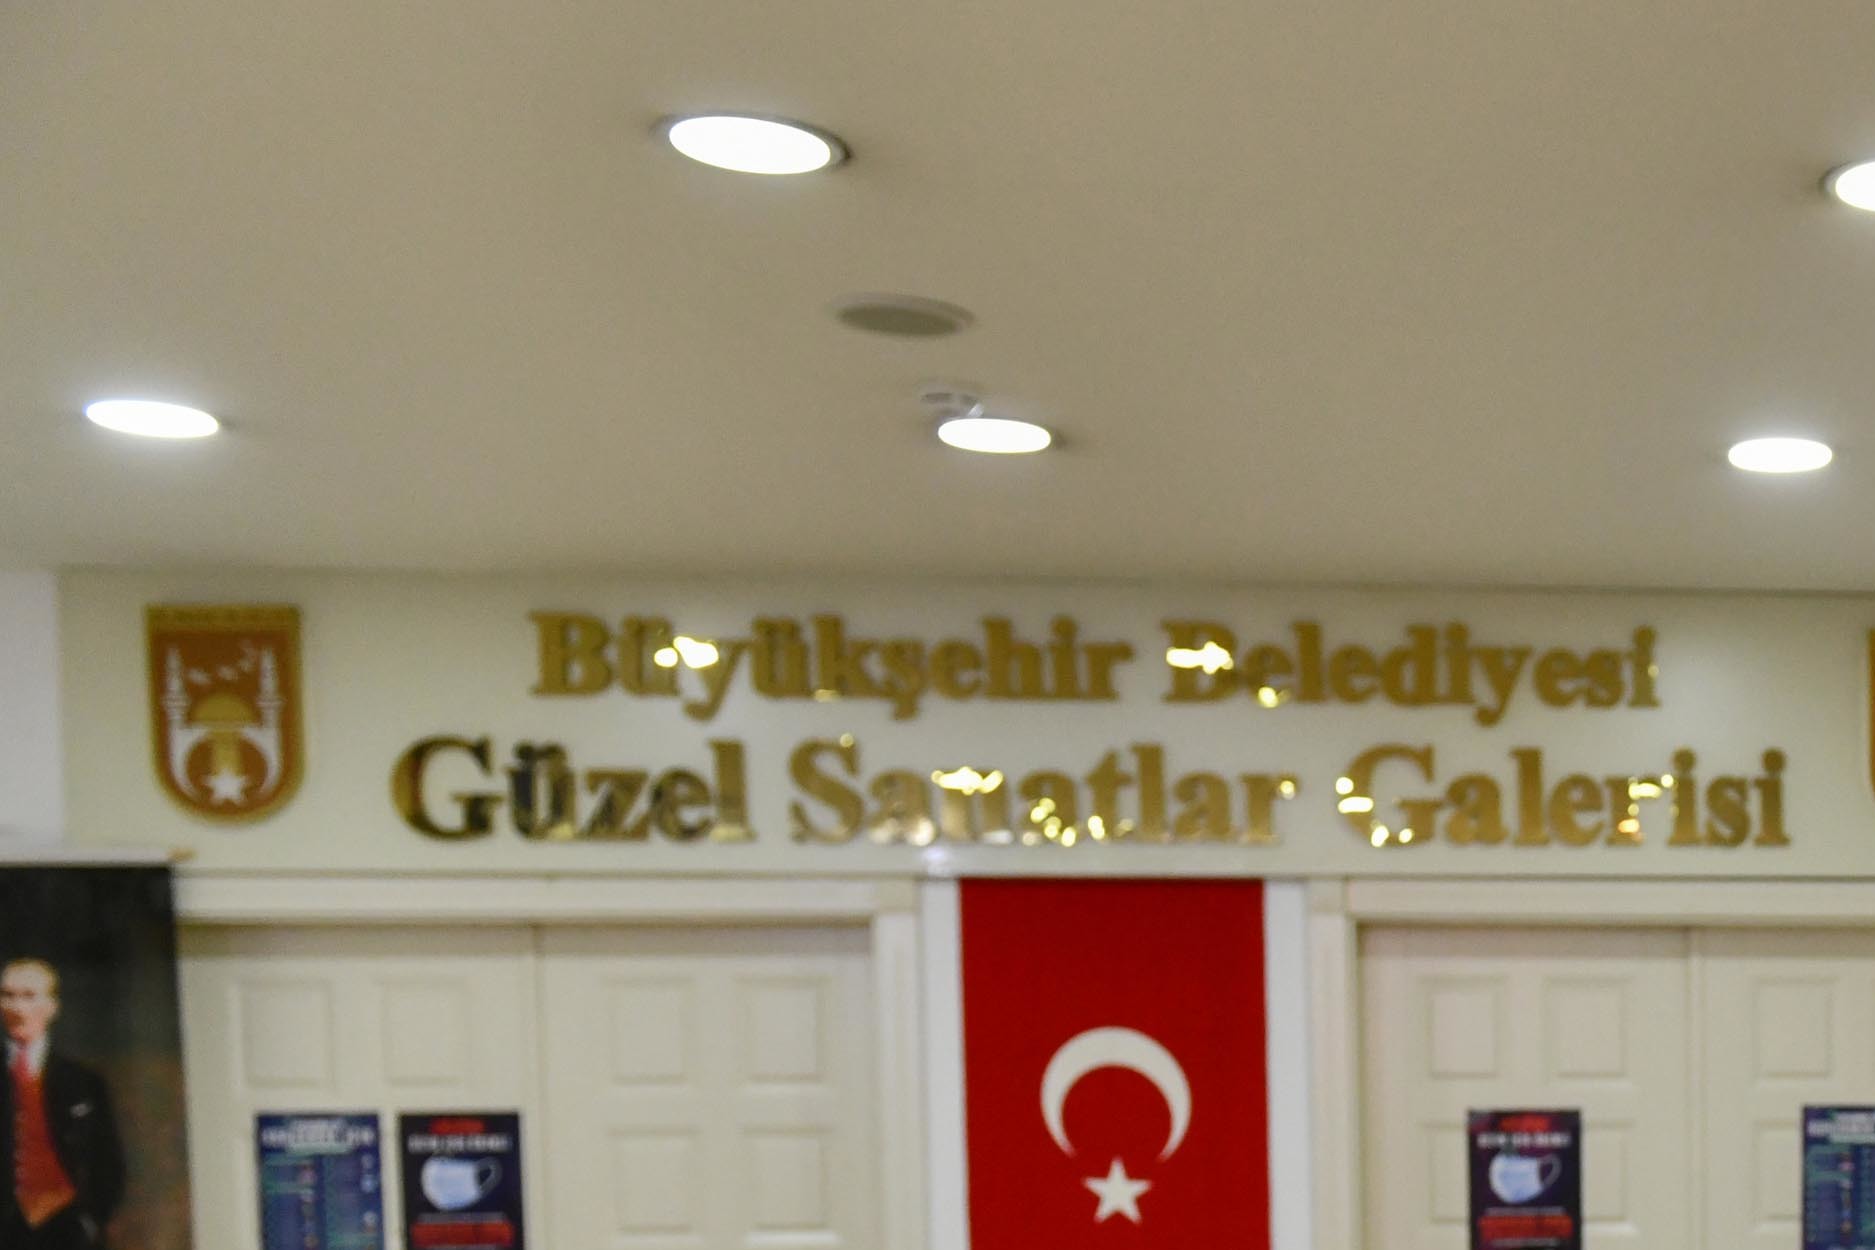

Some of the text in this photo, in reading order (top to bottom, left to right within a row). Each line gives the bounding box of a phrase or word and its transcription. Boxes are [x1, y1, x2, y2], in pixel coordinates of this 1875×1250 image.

[530, 609, 1661, 727] Büyükşehir Belediyesi
[390, 735, 1791, 848] Güzel Sanatlar Galerisi
